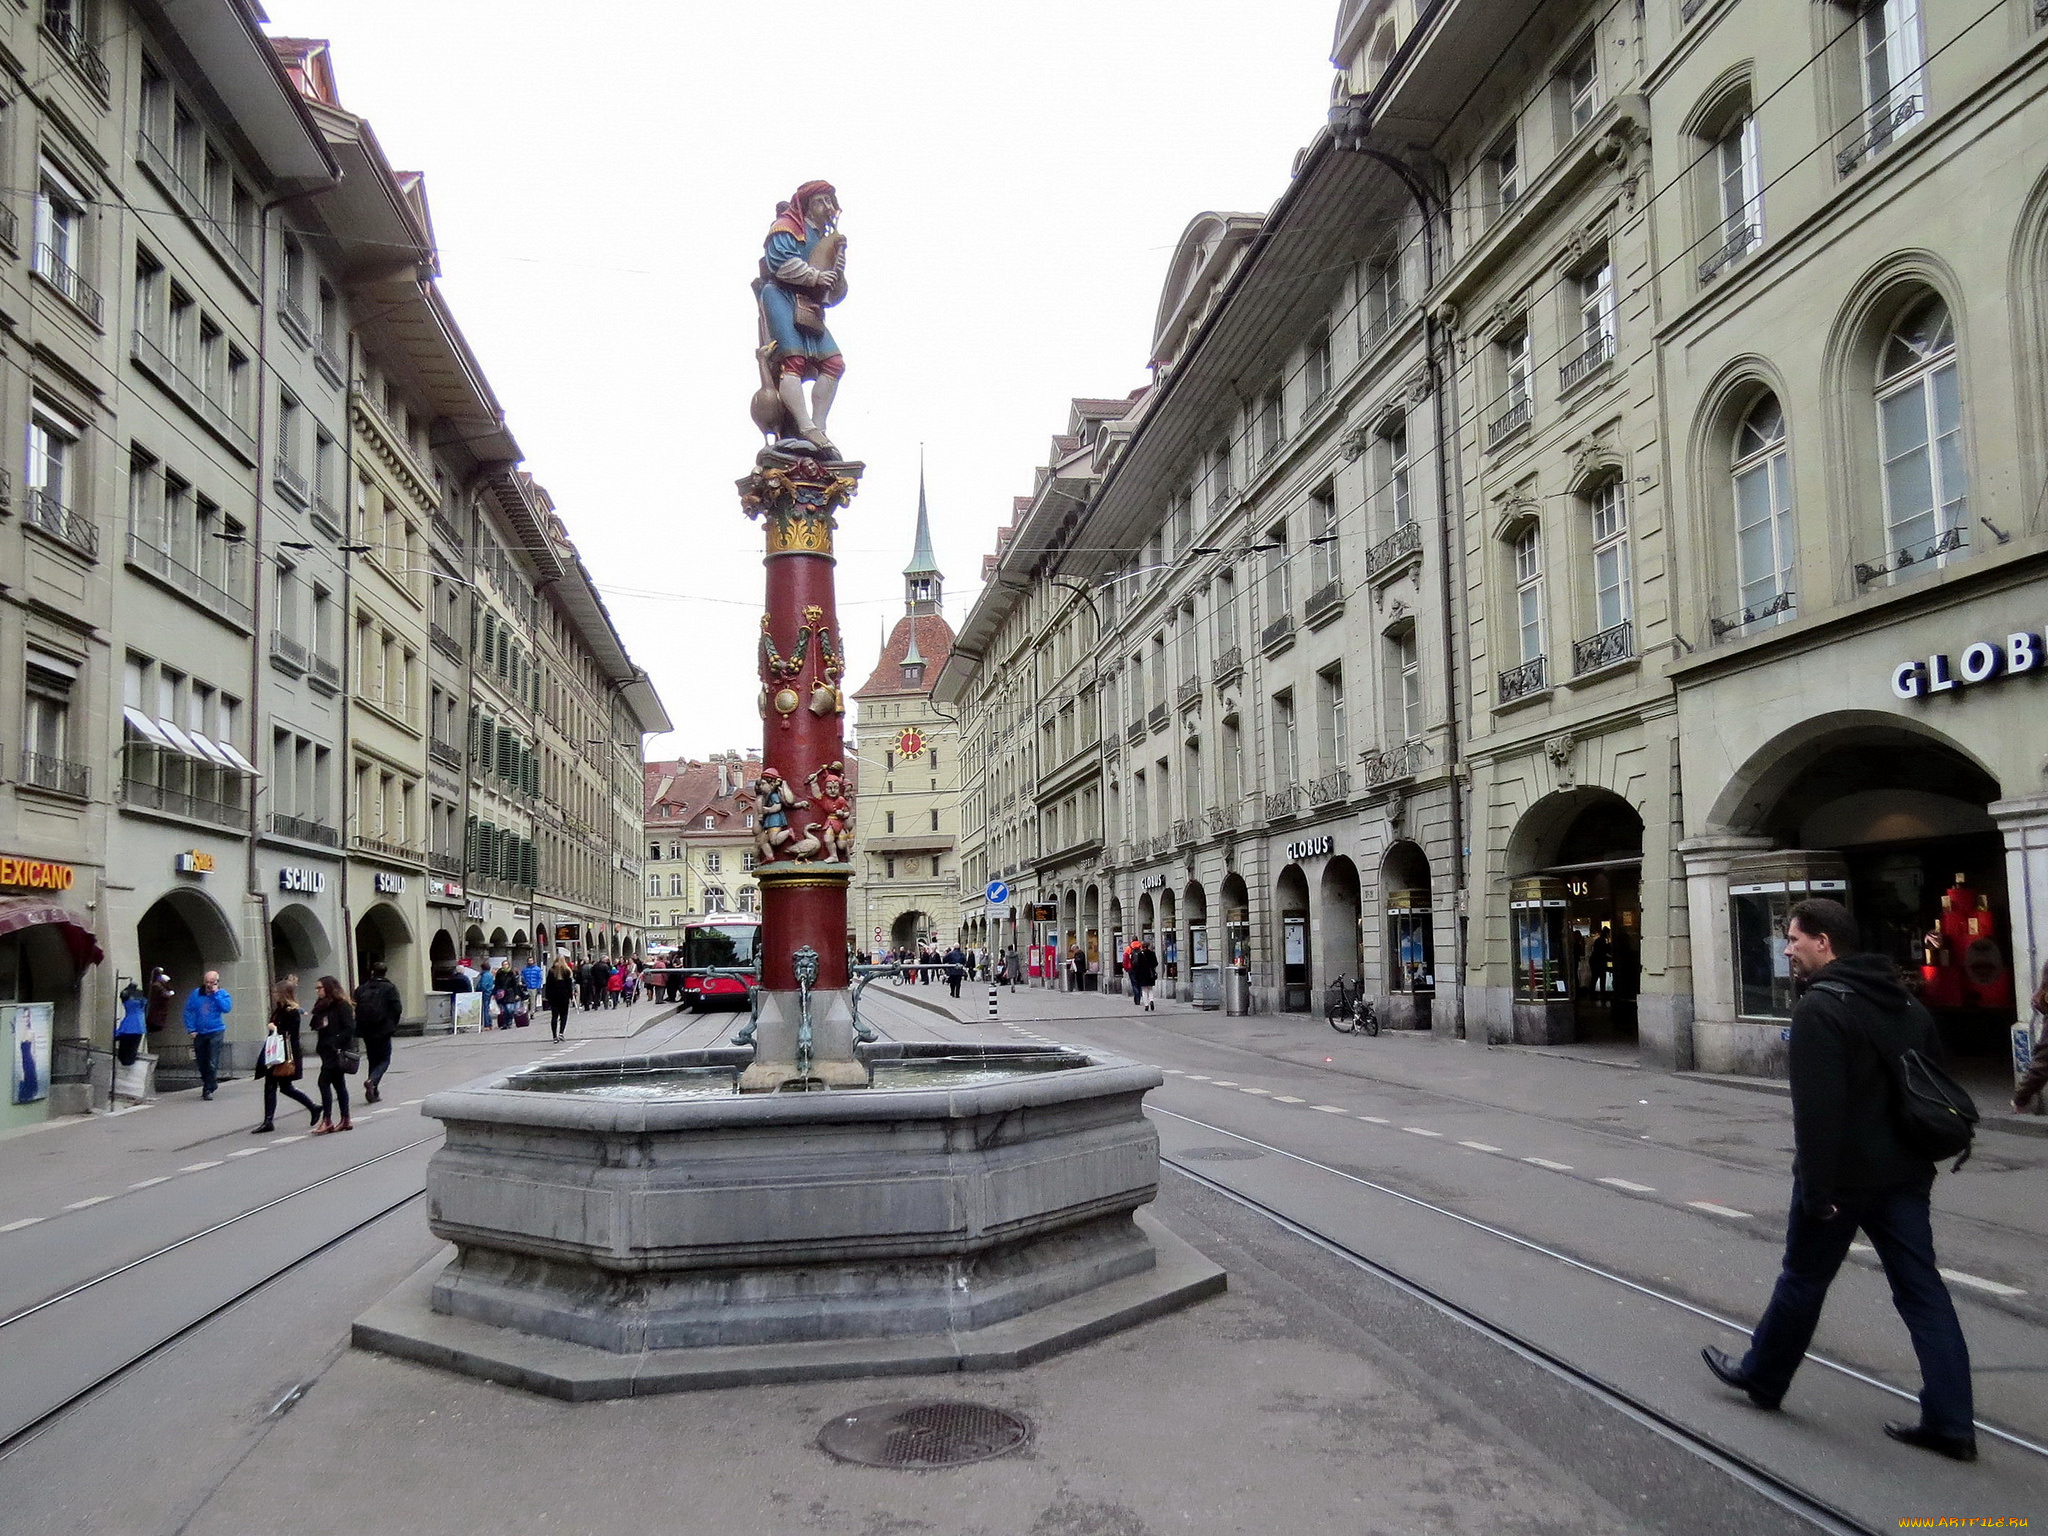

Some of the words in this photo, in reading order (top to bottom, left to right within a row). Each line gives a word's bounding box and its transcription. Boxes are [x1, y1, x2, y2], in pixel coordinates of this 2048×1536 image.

[1891, 625, 2048, 699] GLOB
[1286, 836, 1330, 860] GLOBUS
[0, 858, 74, 890] EXICANO
[286, 866, 326, 893] SCHILD
[380, 872, 406, 894] SCHILD
[1140, 874, 1163, 889] GLOBUS
